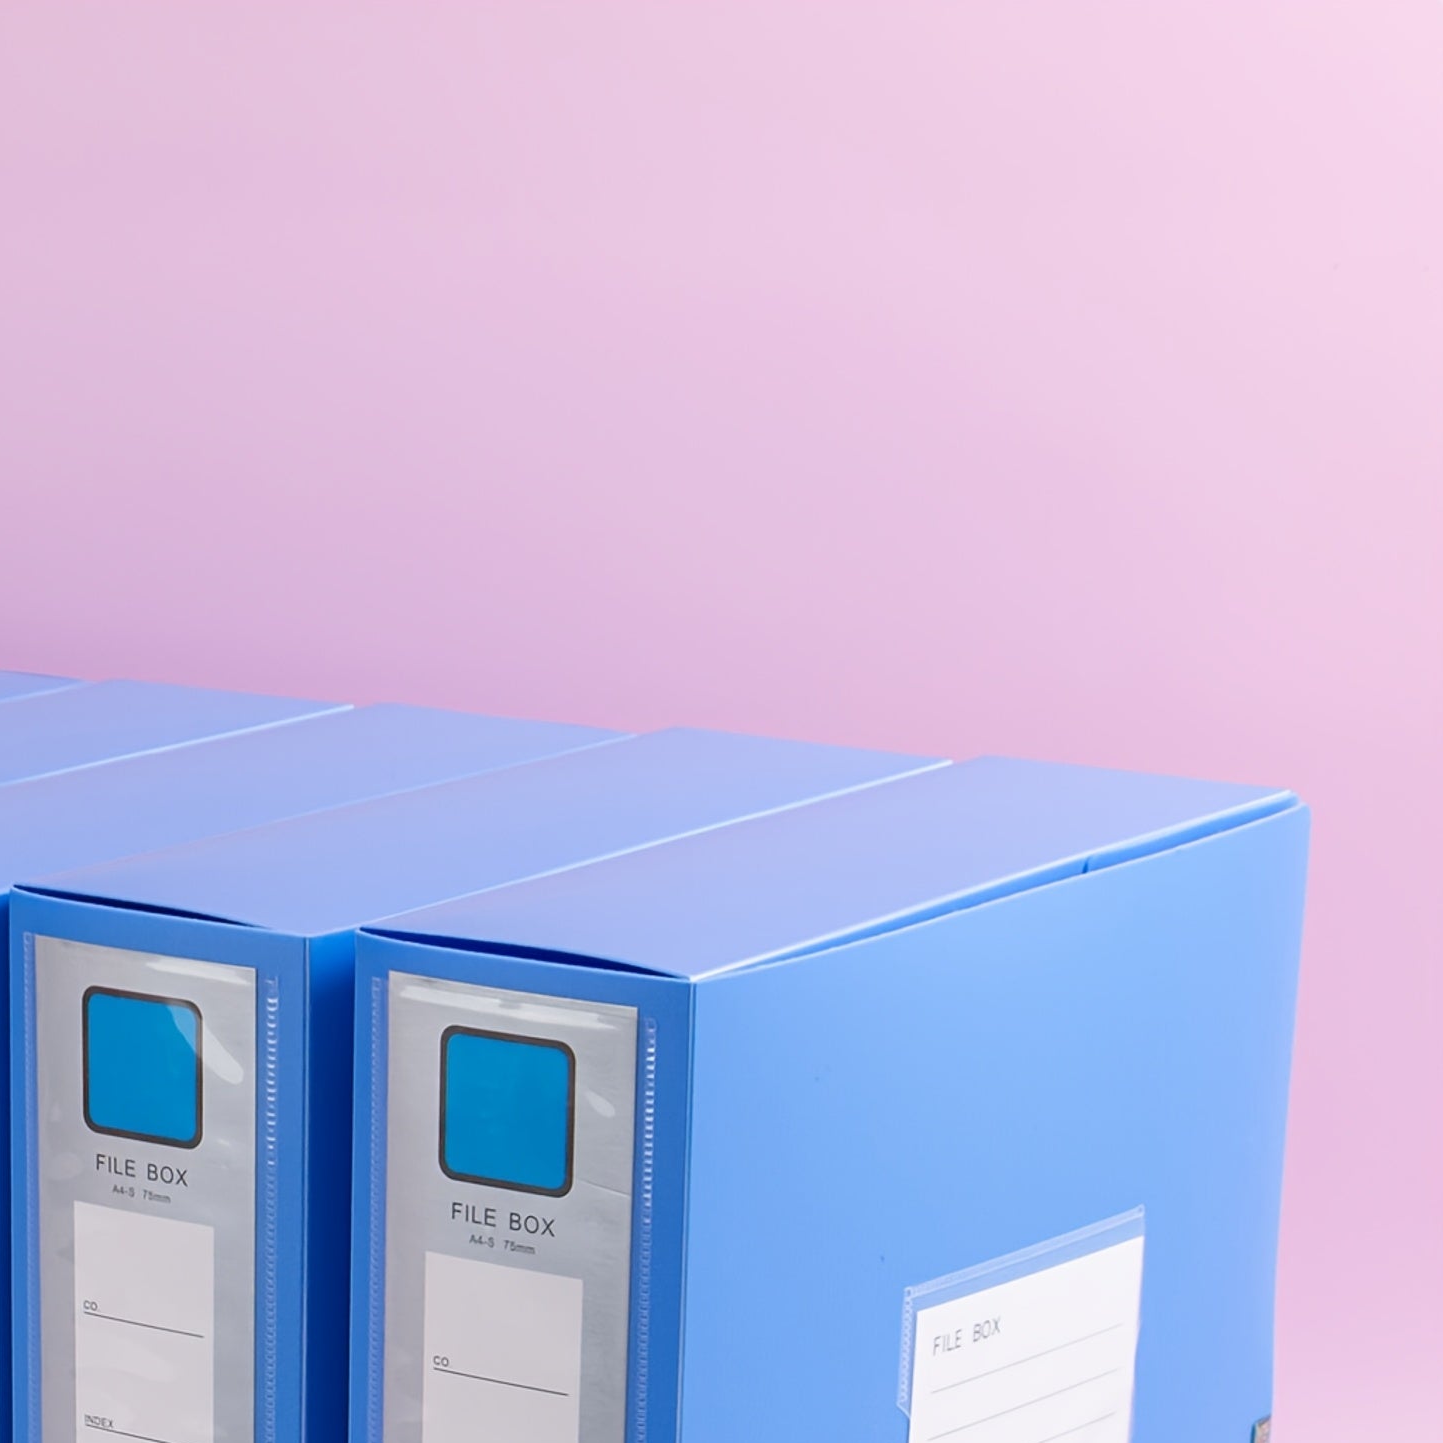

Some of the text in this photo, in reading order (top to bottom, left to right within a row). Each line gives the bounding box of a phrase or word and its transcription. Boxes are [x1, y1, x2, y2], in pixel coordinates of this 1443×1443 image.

[96, 1153, 189, 1187] FILE BOX
[112, 1184, 135, 1198] A4-S
[451, 1202, 556, 1238] FILE BOX
[469, 1234, 536, 1255] A4-S 75mm
[933, 1315, 1001, 1356] FILE BOX
